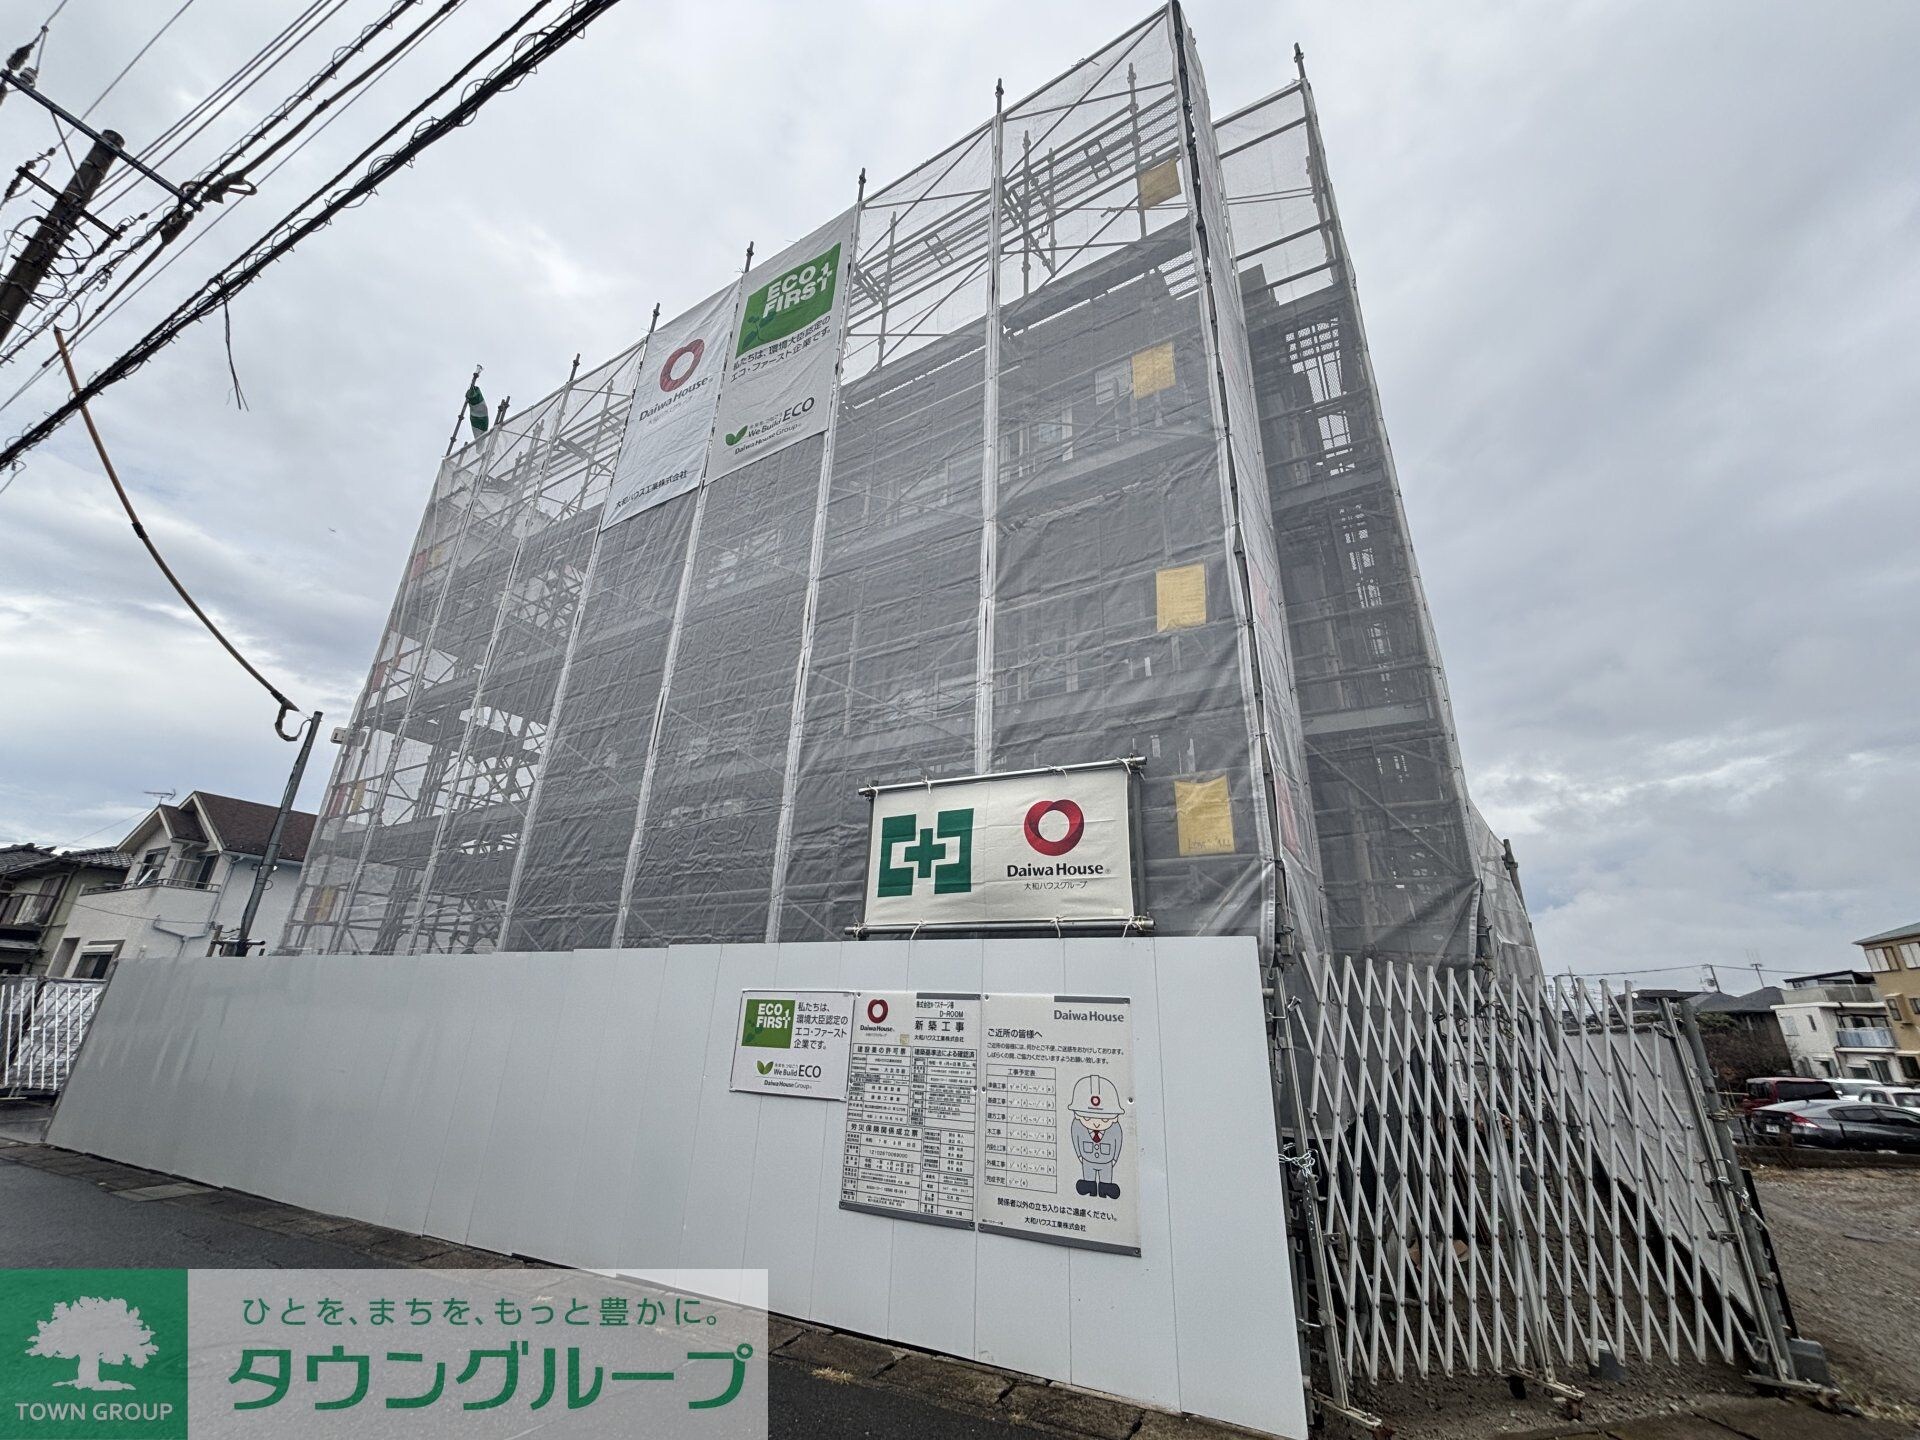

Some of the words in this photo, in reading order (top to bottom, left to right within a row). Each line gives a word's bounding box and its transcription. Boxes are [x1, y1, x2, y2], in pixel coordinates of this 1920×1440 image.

[768, 264, 816, 300] ECO
[762, 267, 832, 318] FIRST
[639, 398, 672, 421] Daiwa
[673, 377, 709, 401] House
[782, 397, 815, 422] ECO
[776, 423, 798, 436] Group
[614, 469, 688, 510] 大和ハウス工業株式会社
[1007, 863, 1054, 877] Daiwa
[1056, 862, 1104, 876] House
[1024, 880, 1088, 891] 大和ハウスグループ
[757, 1003, 783, 1016] ECO
[797, 1002, 830, 1012] 私たちは、
[756, 1011, 791, 1029] FIRST
[796, 1014, 848, 1026] 環境大臣認定の
[1053, 1010, 1088, 1021] Daiwa
[1089, 1011, 1125, 1022] House
[795, 1027, 847, 1038] エコ・ファースト
[915, 1020, 965, 1032] 新築工事
[987, 1028, 1043, 1039] ご近所の皆様へ
[793, 1039, 827, 1050] 企業です。
[798, 1064, 822, 1079] ECO
